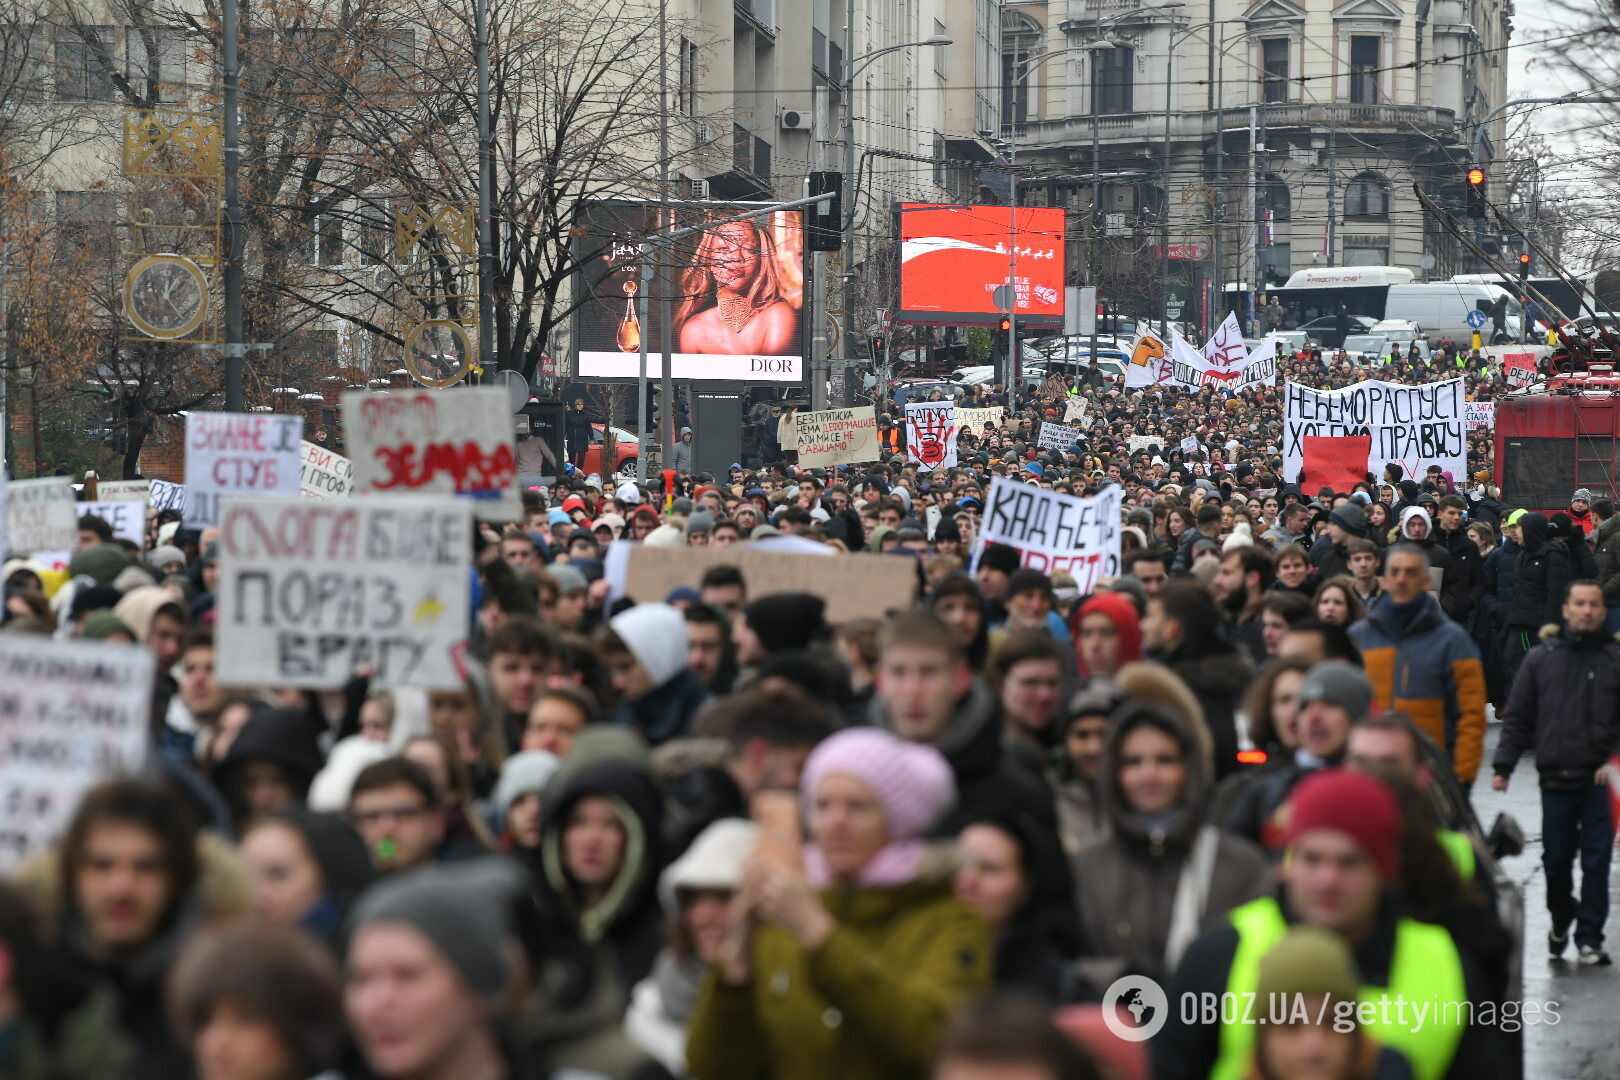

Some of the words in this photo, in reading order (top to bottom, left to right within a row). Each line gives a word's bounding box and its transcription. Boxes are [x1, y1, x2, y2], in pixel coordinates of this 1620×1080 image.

[750, 358, 793, 373] DIOR
[796, 414, 815, 426] БЕЗ
[815, 410, 853, 423] ПРИТИСКА
[1288, 384, 1366, 424] НЕЋЕМО
[796, 424, 821, 435] НЕМА
[823, 417, 876, 434] ДЕФОРМАЦИЈЕ
[797, 435, 815, 446] АЛИ
[816, 432, 829, 443] МИ
[831, 432, 841, 443] СЕ
[843, 430, 855, 440] НЕ
[1380, 421, 1462, 460] ПРАВДУ
[797, 441, 847, 456] САВИЈАМО
[212, 455, 280, 490] СТУБ
[222, 505, 360, 560] СЛОГА
[988, 485, 1051, 547] КАД
[234, 567, 406, 631] ПОРАЗ
